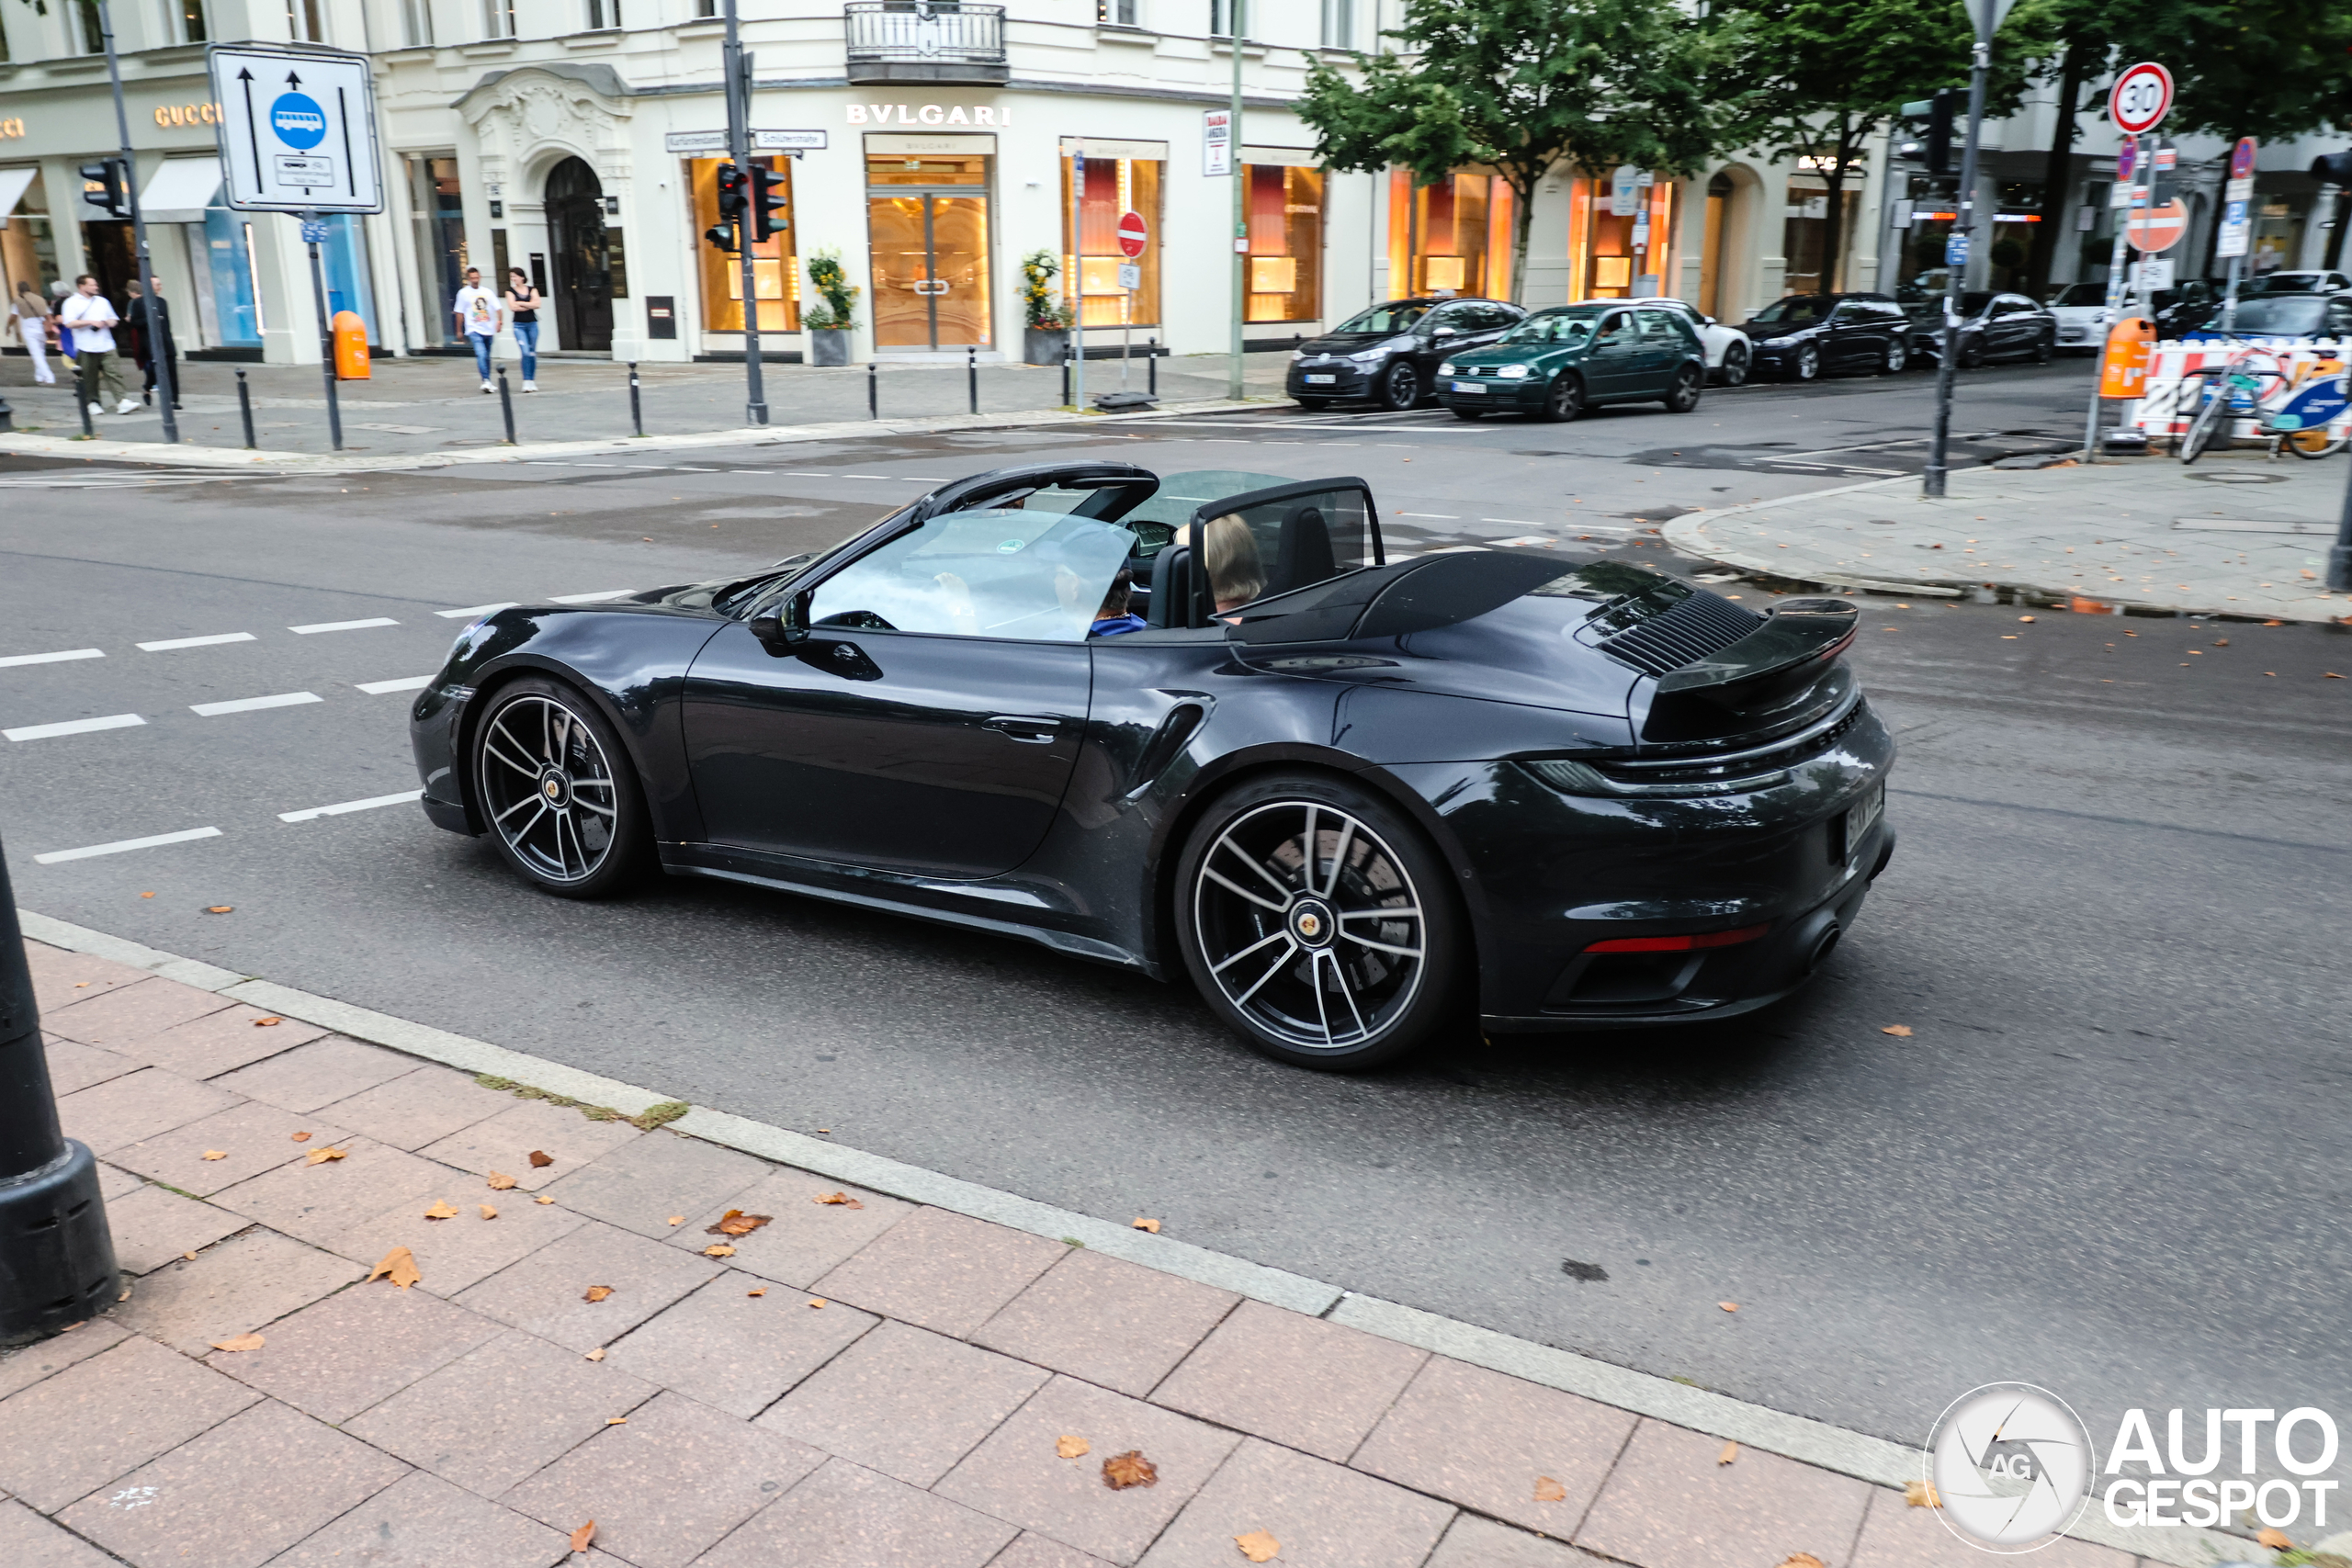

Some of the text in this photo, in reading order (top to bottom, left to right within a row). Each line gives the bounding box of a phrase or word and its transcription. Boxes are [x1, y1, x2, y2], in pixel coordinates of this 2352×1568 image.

[2120, 83, 2157, 113] 30
[154, 102, 223, 127] GUCCI
[845, 104, 1011, 127] BVLGARI
